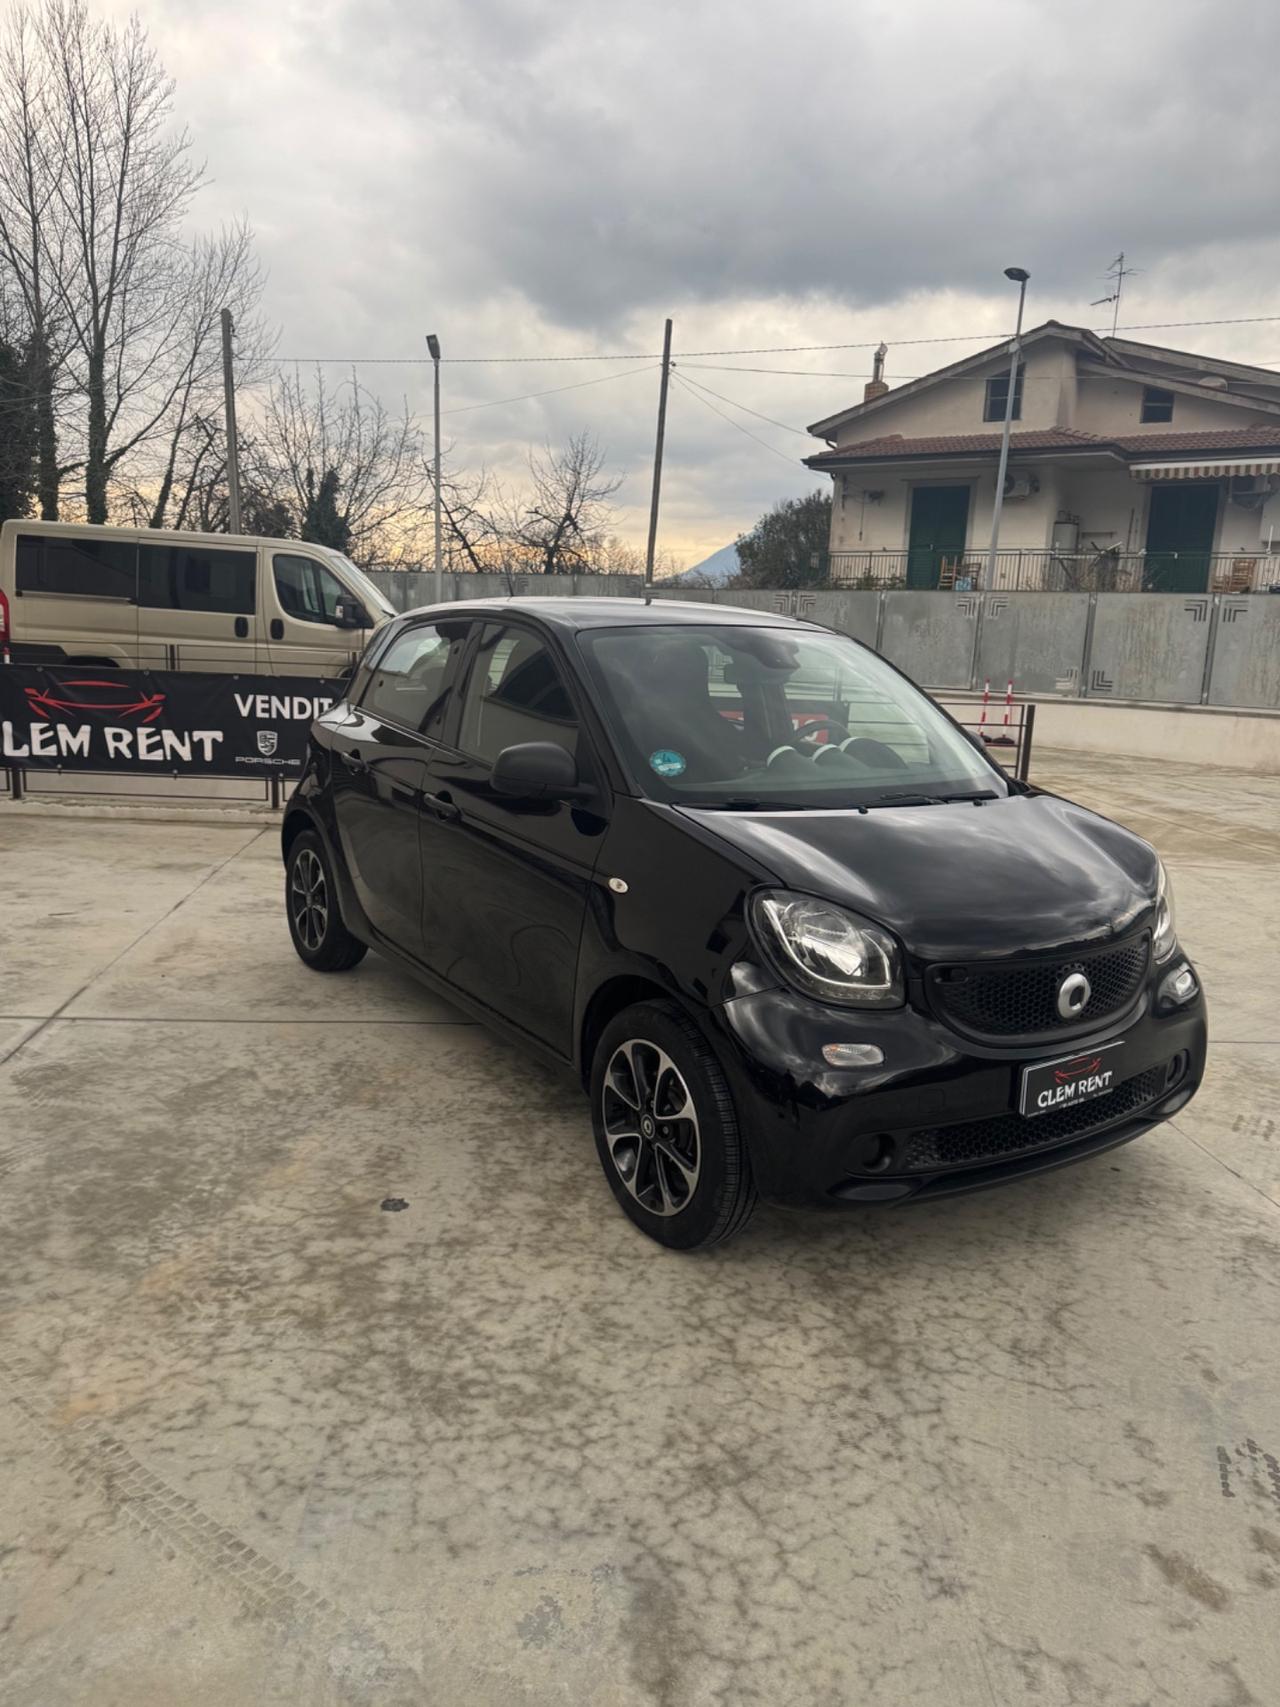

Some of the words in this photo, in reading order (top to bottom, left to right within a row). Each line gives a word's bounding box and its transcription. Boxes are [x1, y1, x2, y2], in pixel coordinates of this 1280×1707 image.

[2, 720, 91, 757] LEM
[103, 726, 223, 762] RENT
[1038, 1083, 1075, 1108] CLEM
[1078, 1071, 1113, 1095] RENT
